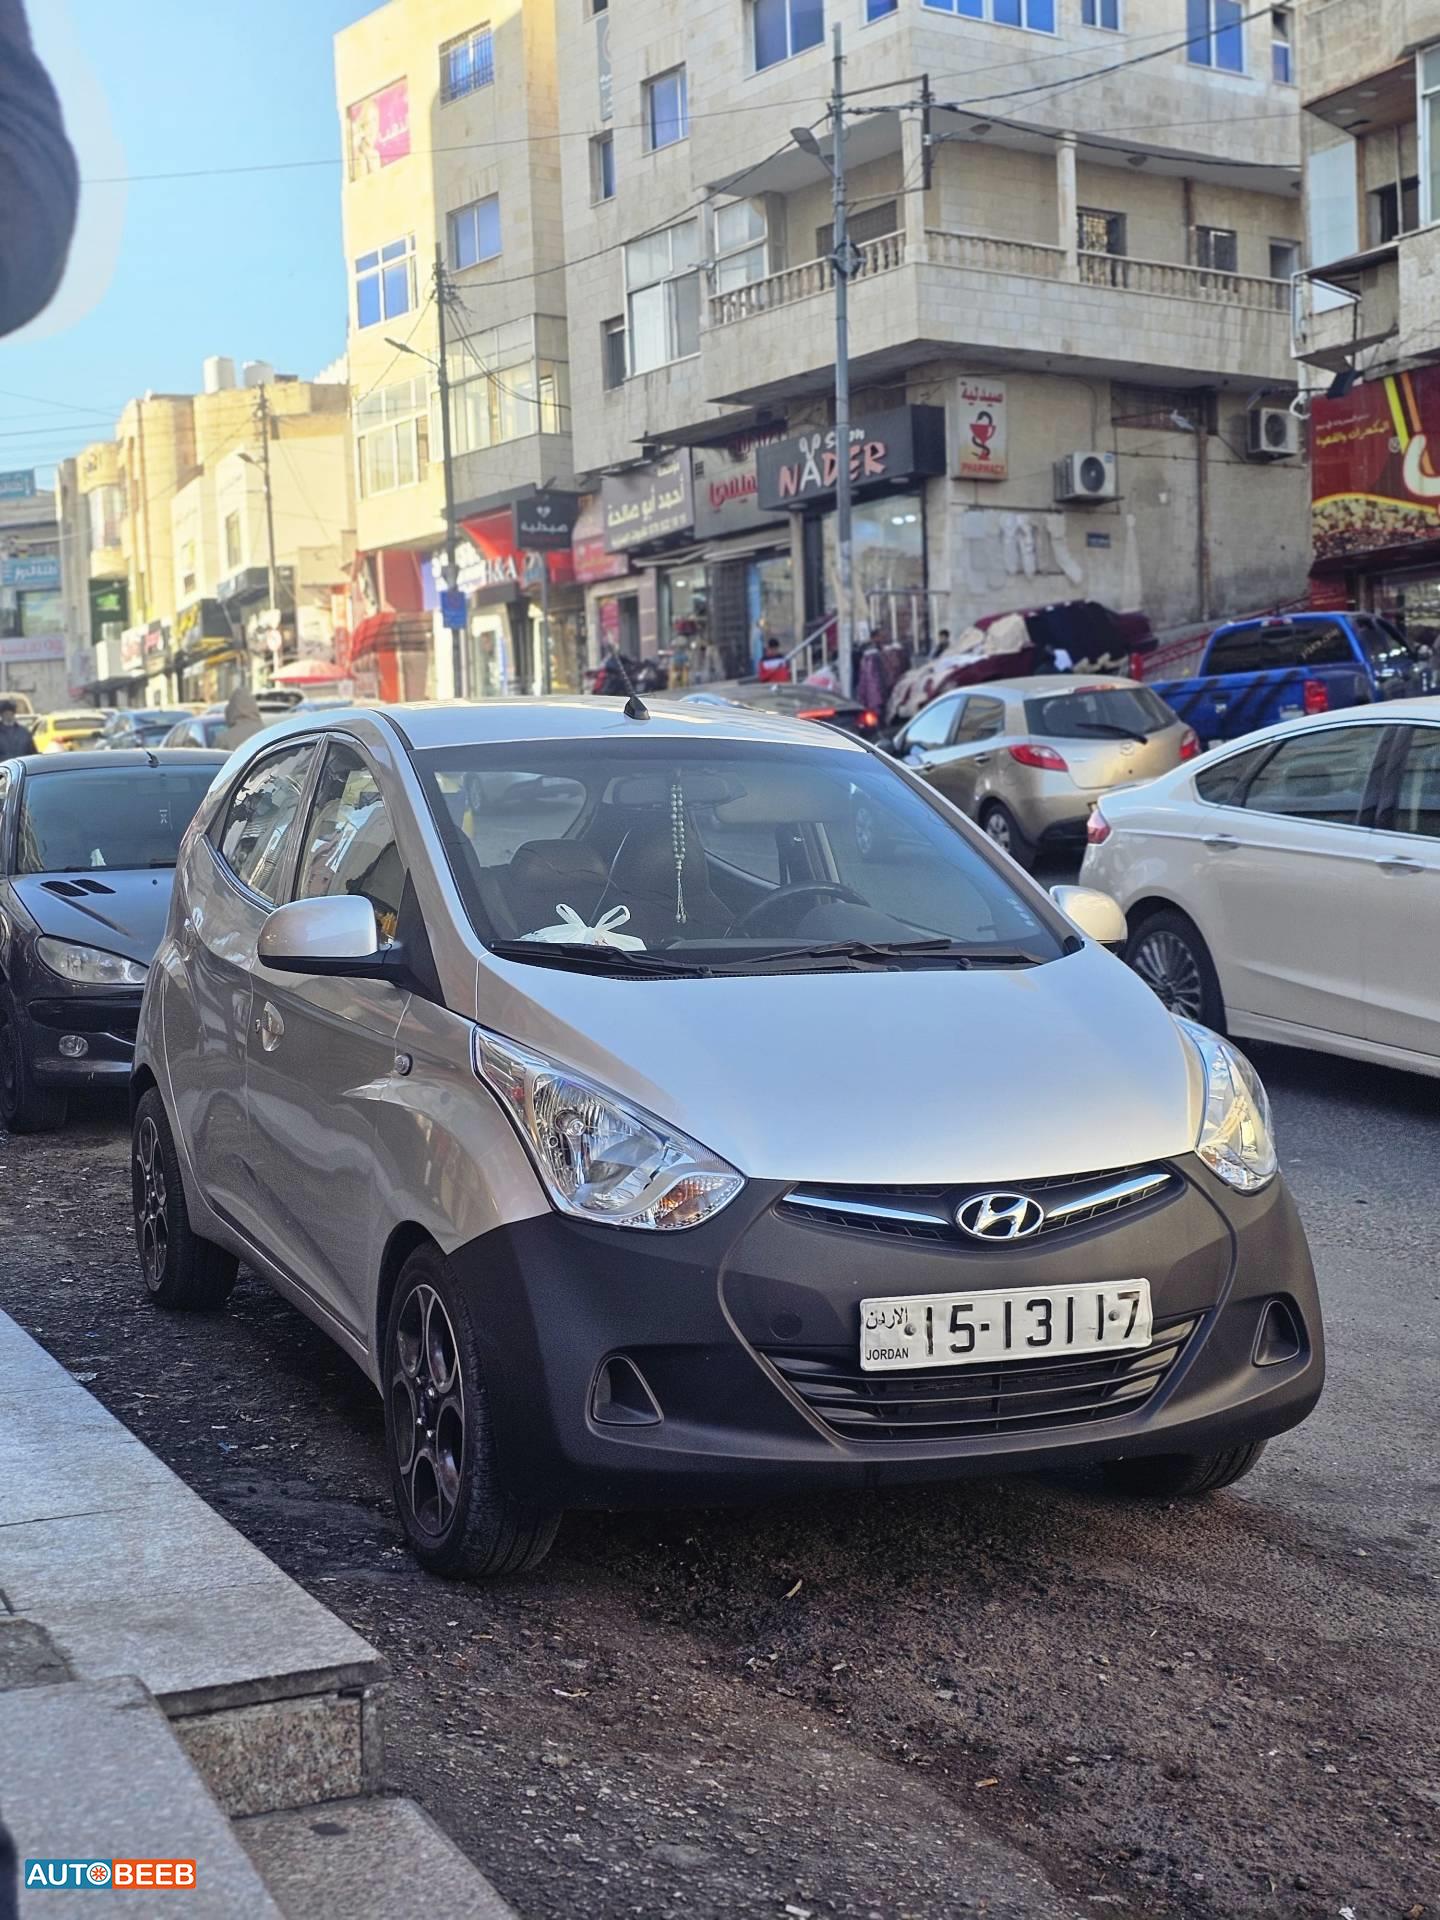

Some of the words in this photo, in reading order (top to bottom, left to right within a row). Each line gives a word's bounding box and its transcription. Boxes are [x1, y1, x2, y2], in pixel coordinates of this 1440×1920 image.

[960, 380, 1004, 408] صيدلية
[641, 484, 657, 522] أبو
[657, 471, 686, 510] أحمد
[926, 1291, 1141, 1356] 15-13117
[866, 1348, 909, 1361] JORDAN
